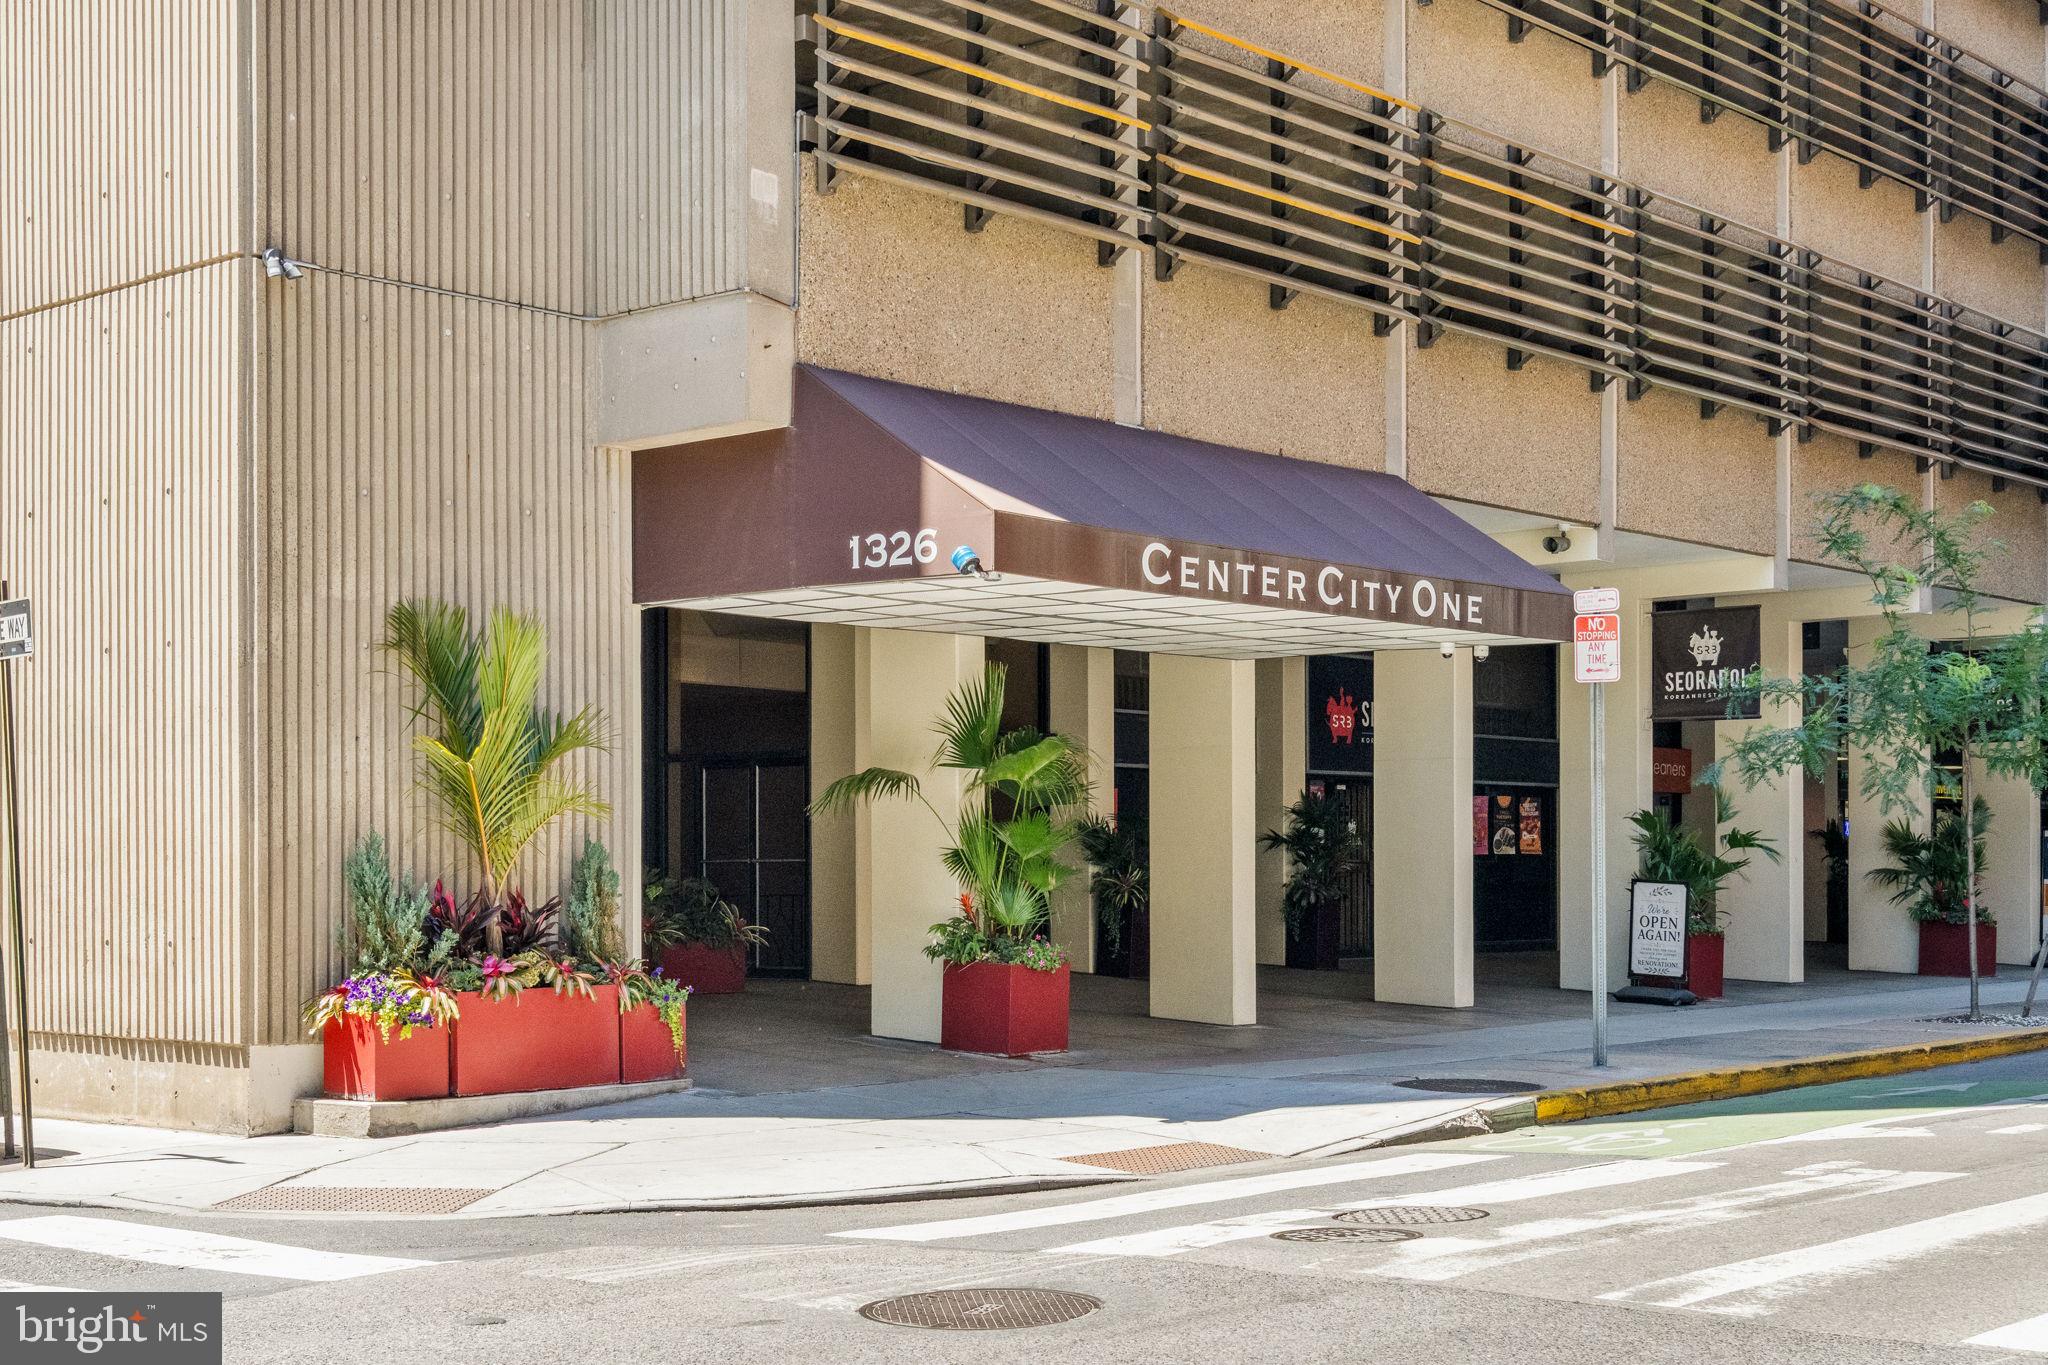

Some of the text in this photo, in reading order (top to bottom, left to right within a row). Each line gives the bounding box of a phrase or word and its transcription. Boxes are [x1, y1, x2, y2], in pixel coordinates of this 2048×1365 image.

[849, 528, 938, 569] 1326
[1141, 542, 1483, 625] CENTER CITY ONE
[7, 616, 25, 639] WAY
[1588, 617, 1606, 631] NO
[1577, 631, 1617, 640] STOPPING
[1588, 642, 1607, 652] ANY
[1587, 653, 1607, 665] TIME
[1639, 915, 1678, 929] OPEN
[1637, 929, 1680, 942] AGAIN!
